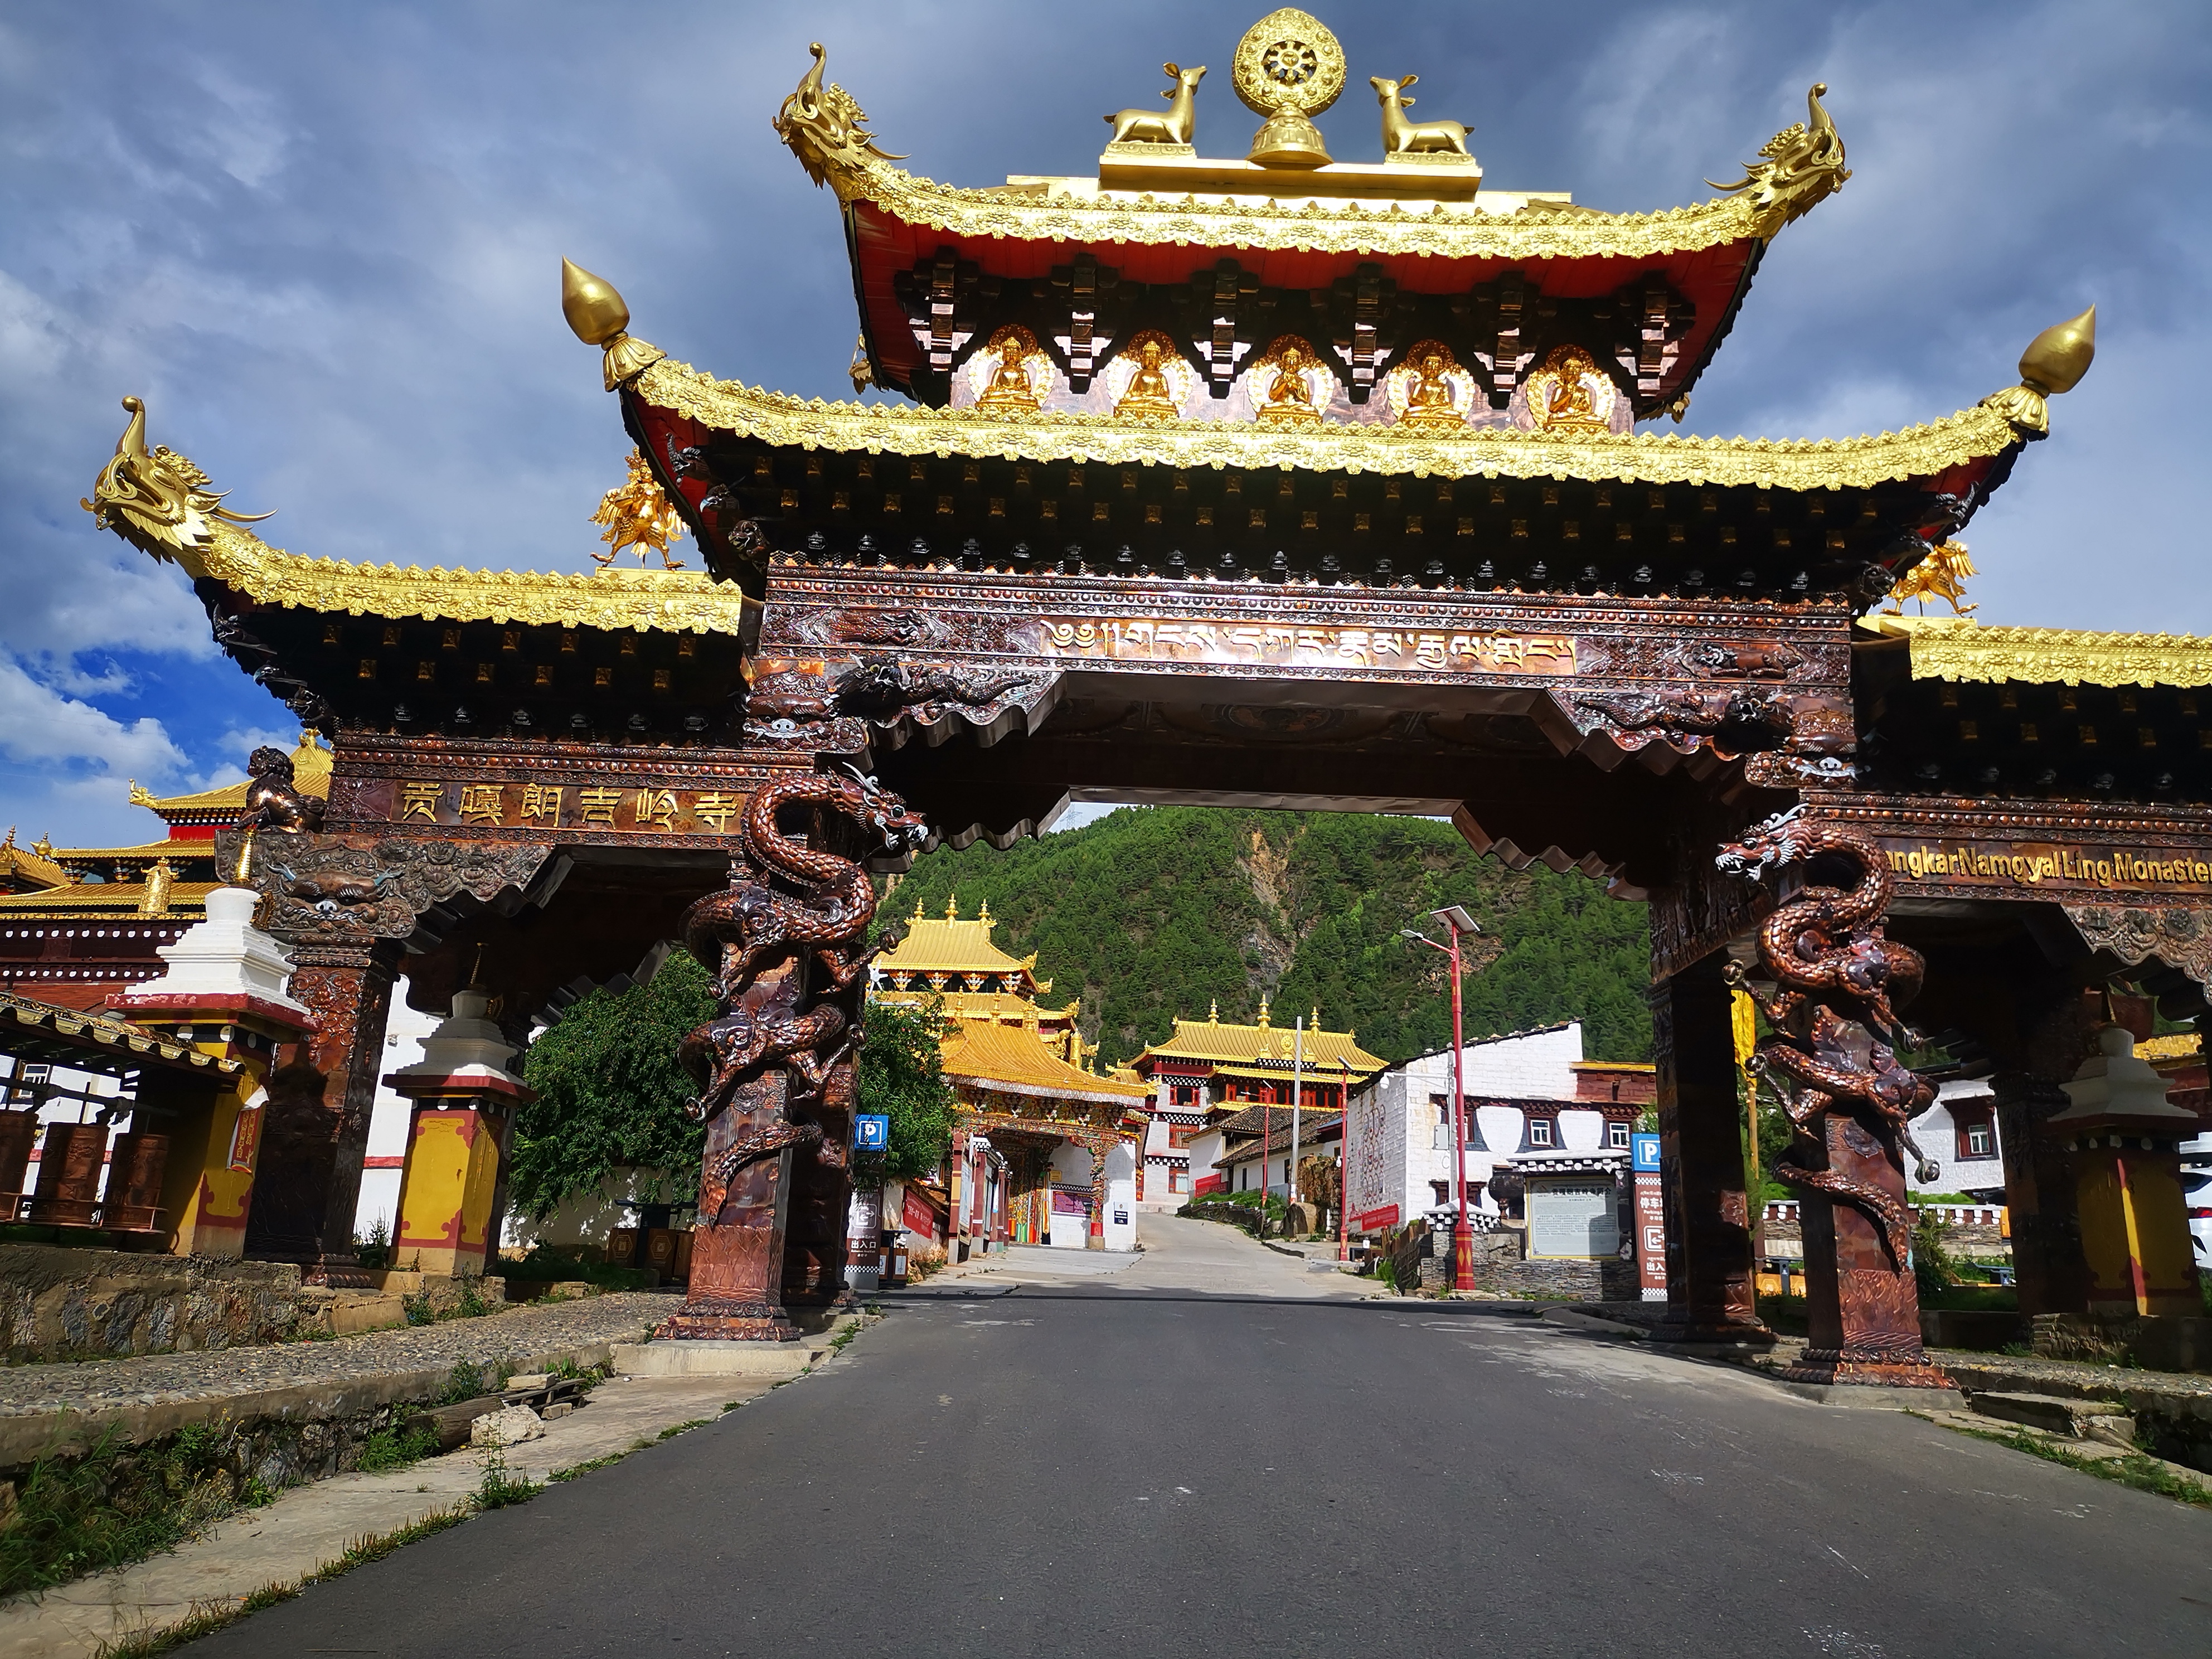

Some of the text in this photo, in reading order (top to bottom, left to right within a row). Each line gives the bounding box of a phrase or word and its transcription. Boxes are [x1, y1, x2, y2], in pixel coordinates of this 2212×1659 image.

[401, 783, 738, 834] 贡嘎朗吉岭寺
[1958, 847, 2060, 882] Namgyal
[2061, 851, 2111, 886] Ling
[2113, 852, 2212, 882] Monaste
[1645, 1143, 1657, 1162] P
[1640, 1197, 1662, 1209] 停车
[851, 1240, 876, 1249] 出入口
